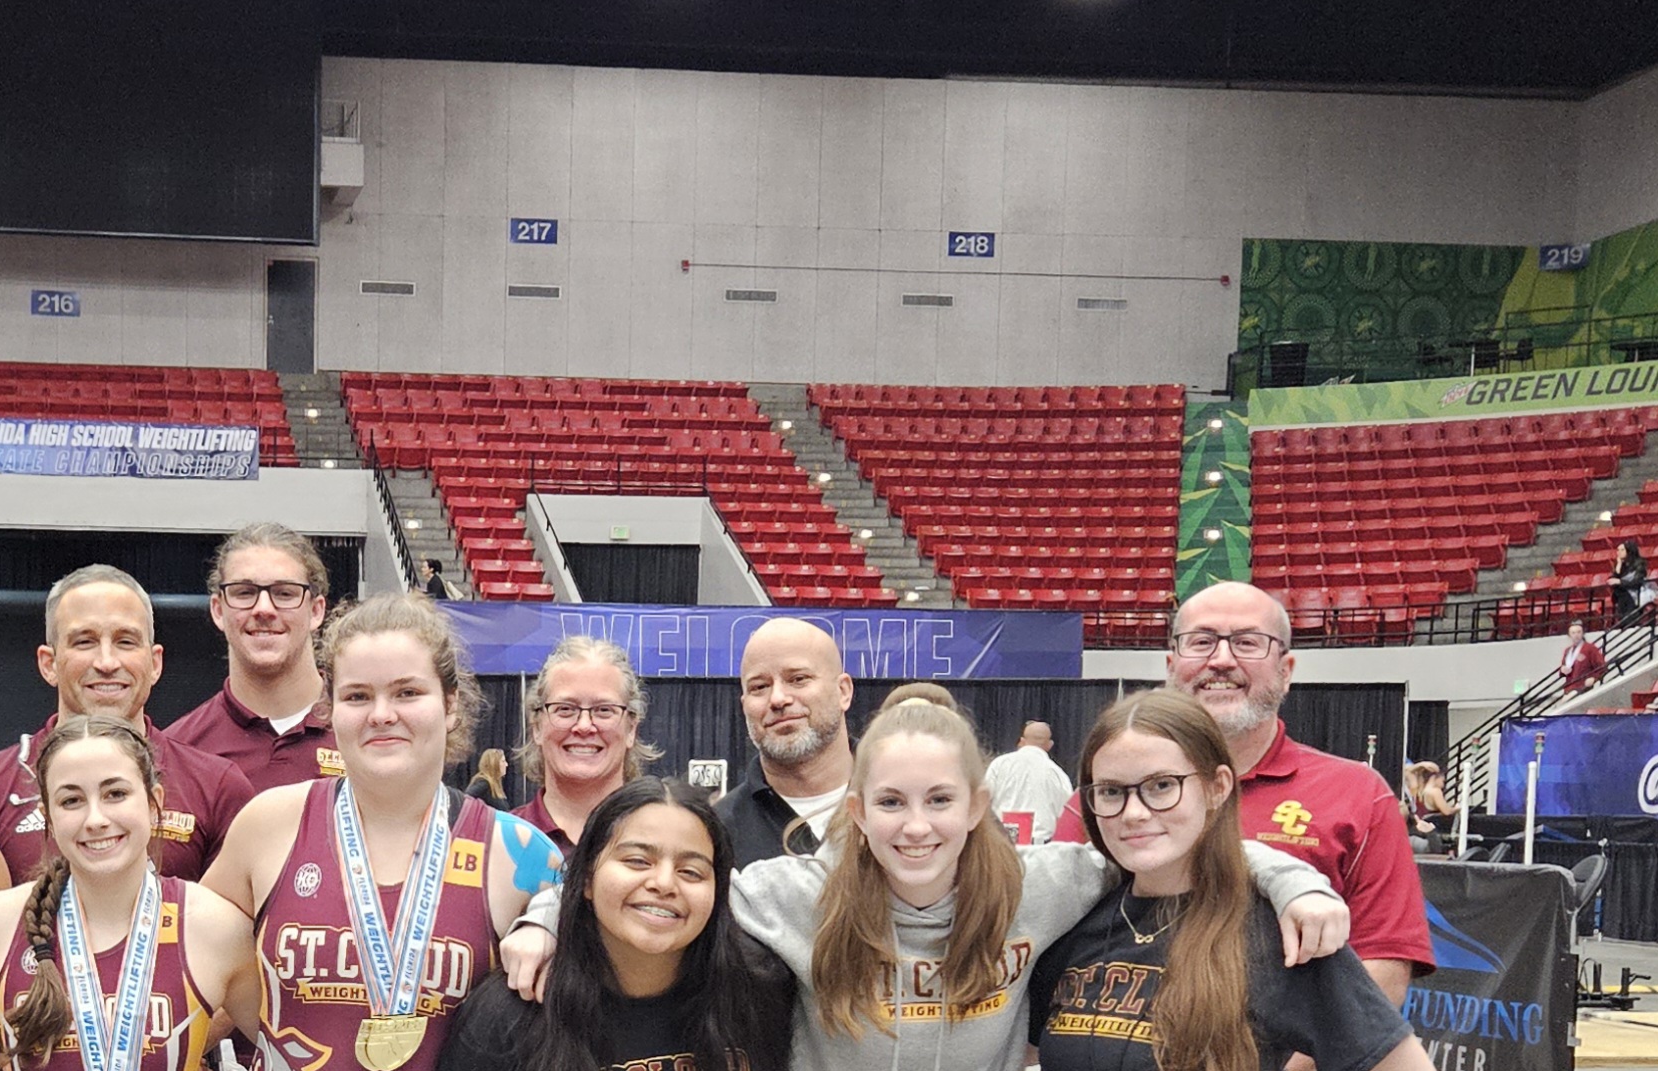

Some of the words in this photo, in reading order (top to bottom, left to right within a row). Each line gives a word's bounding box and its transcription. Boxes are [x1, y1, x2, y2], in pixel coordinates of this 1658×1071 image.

[517, 221, 552, 241] 217
[954, 235, 990, 254] 218
[1545, 247, 1584, 268] 219
[37, 293, 74, 313] 216
[1465, 370, 1581, 406] GREEN
[28, 423, 70, 447] HIGH
[72, 425, 134, 449] SCHOOL
[138, 426, 257, 452] WEIGHTLIFTING
[55, 449, 252, 478] CHAMPIONSHIPS
[560, 612, 955, 678] WELME
[452, 851, 478, 872] LB
[412, 823, 446, 941] WEIGHTLIFTING
[117, 931, 149, 1053] WEIGHTLIFTING
[1402, 986, 1544, 1046] FUNDING
